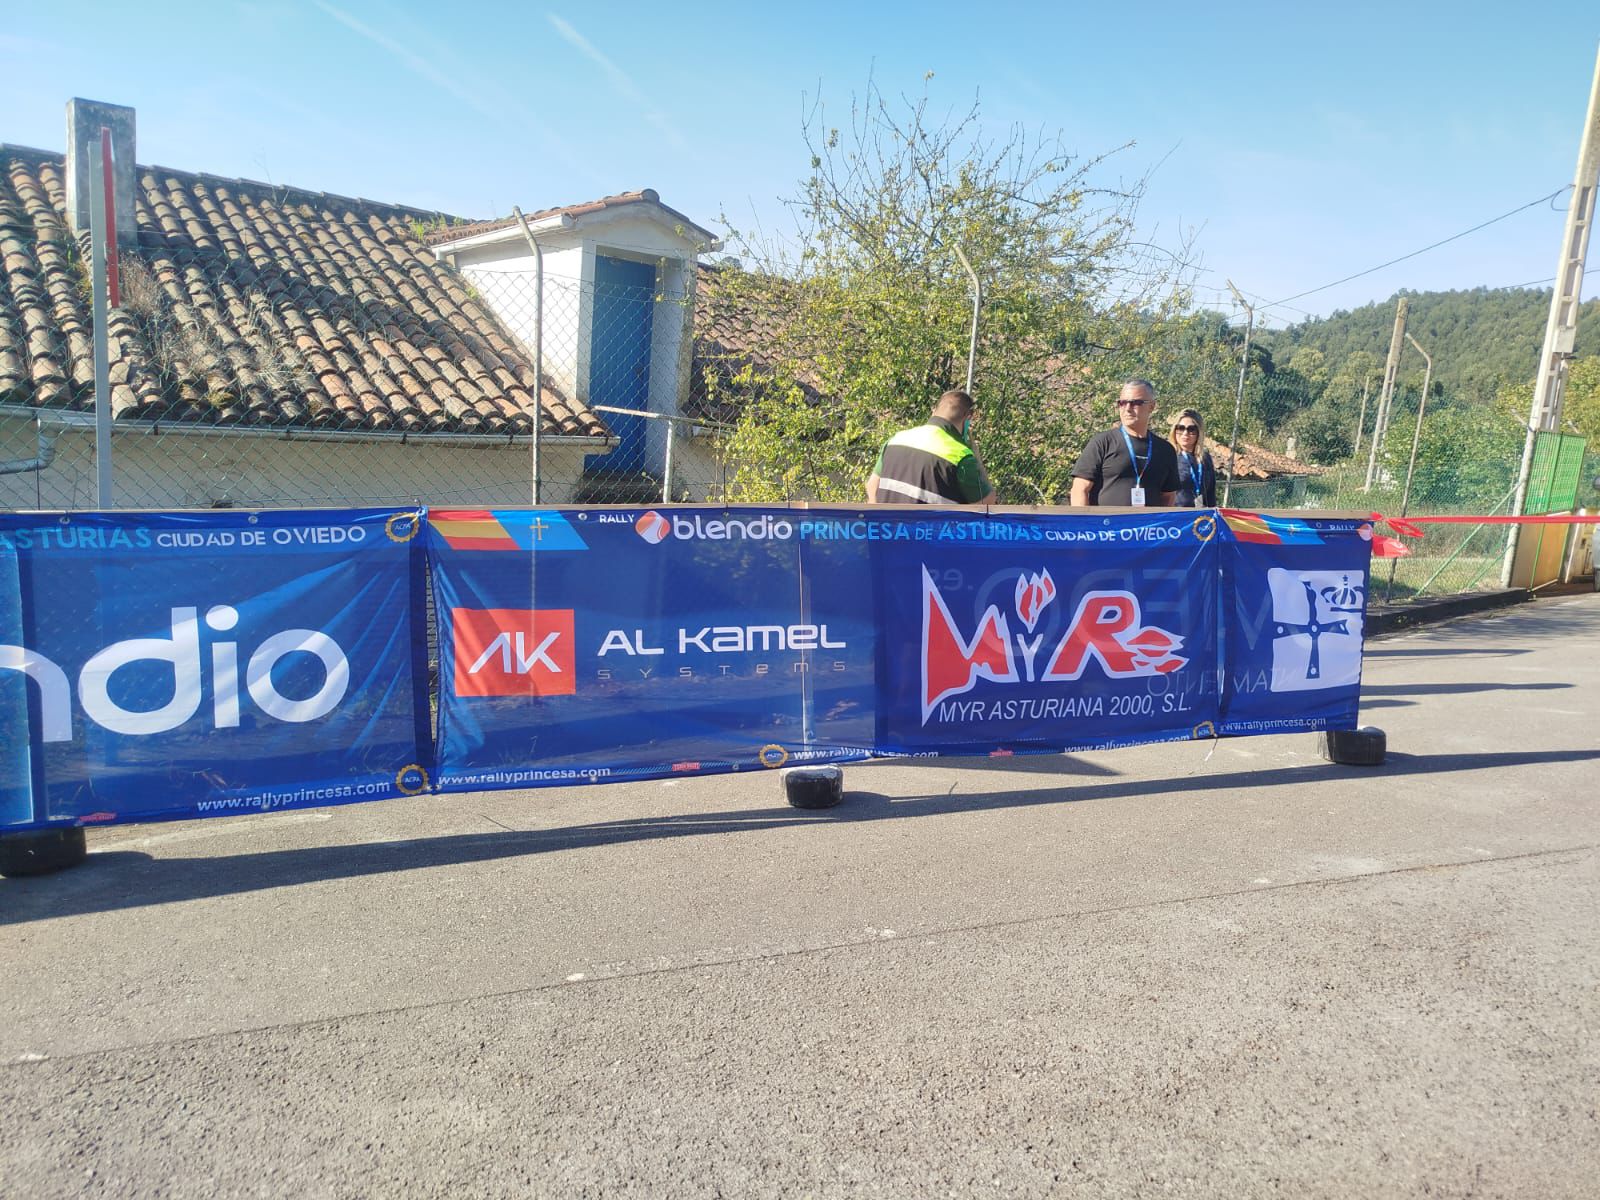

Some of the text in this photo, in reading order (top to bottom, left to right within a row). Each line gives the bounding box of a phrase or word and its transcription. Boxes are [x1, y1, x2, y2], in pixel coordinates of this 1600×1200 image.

[157, 532, 235, 548] CIUDAD
[241, 531, 266, 546] DE
[272, 525, 366, 545] OVIEDO
[599, 514, 635, 524] RALLY
[672, 514, 793, 540] blendio
[800, 520, 910, 541] PRINCESA
[915, 527, 932, 541] DE
[938, 521, 1042, 542] ASTURIAS
[1045, 529, 1096, 542] CIUDAD
[1099, 530, 1116, 542] DE
[1120, 526, 1182, 542] OVIEDO
[597, 629, 665, 657] AL
[938, 693, 1192, 723] MYR ASTURIANA 2000, S.L.
[438, 766, 611, 786] www.rallyprincesa.com
[197, 781, 390, 812] www.rallyprincesa.com
